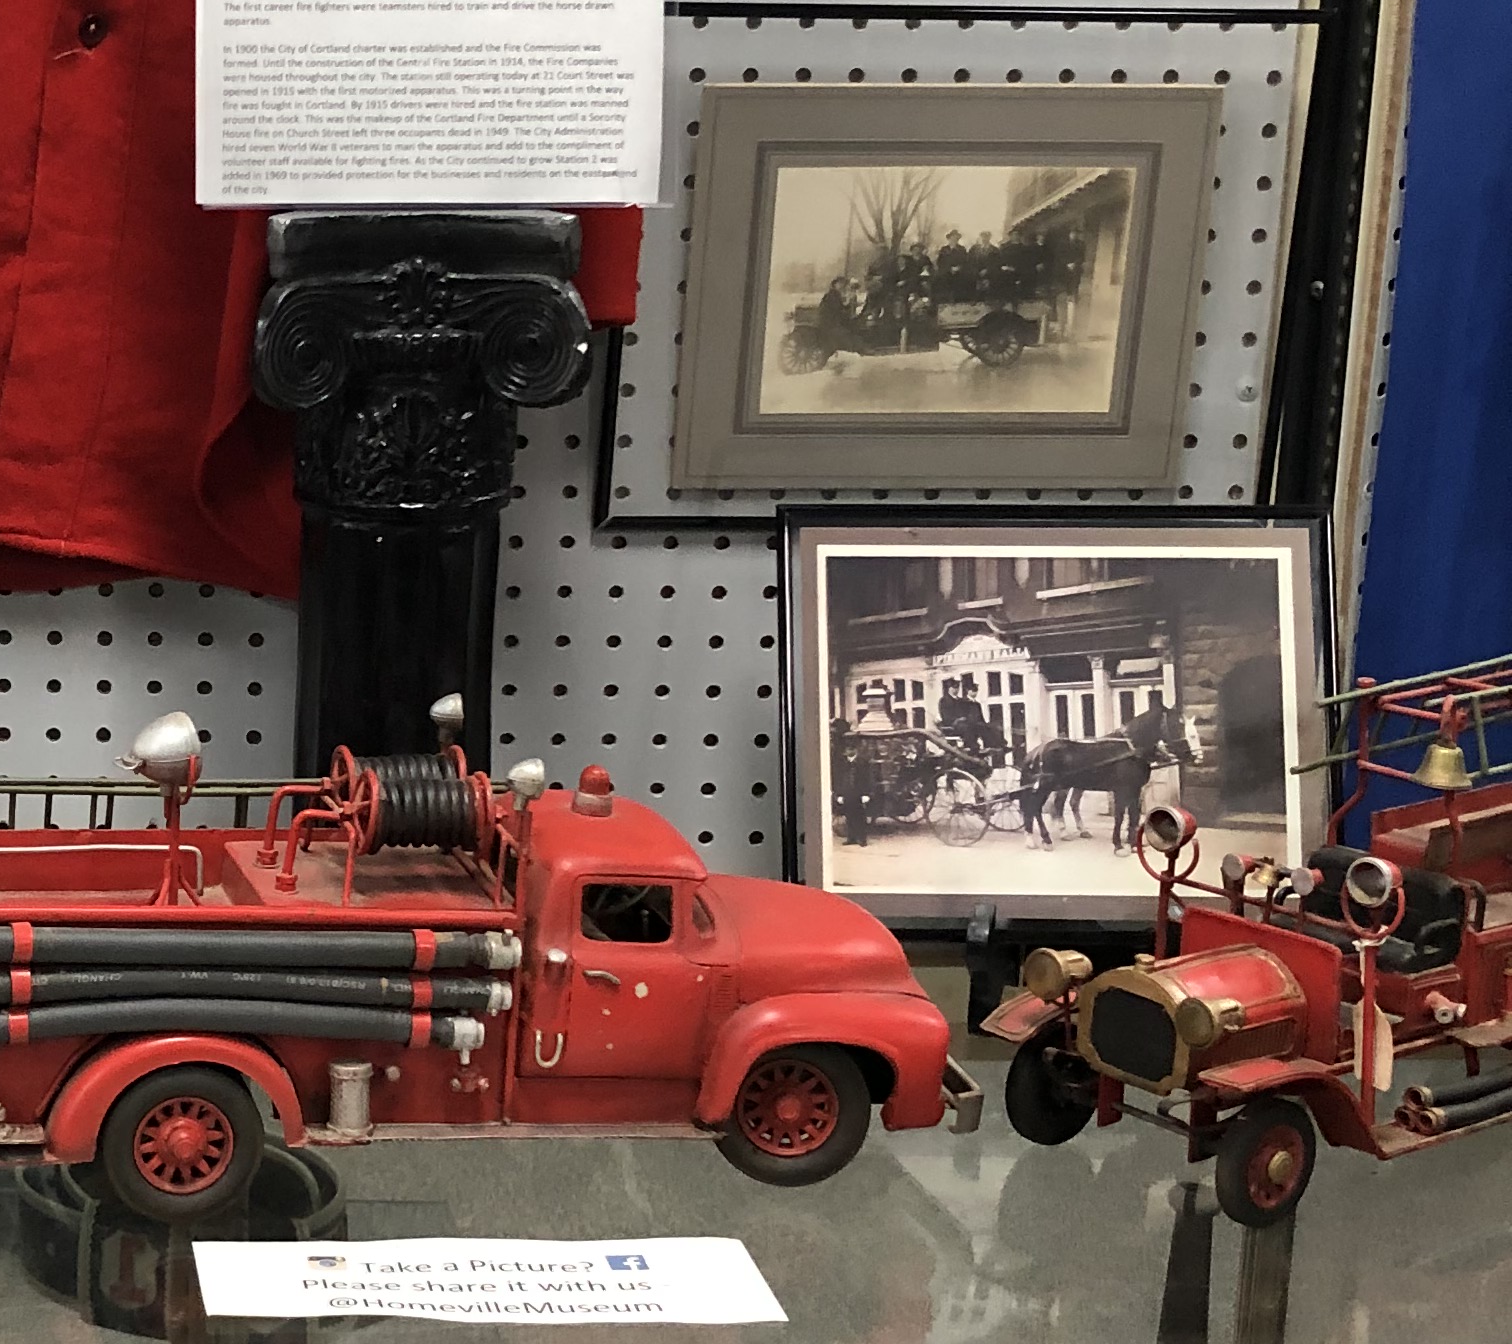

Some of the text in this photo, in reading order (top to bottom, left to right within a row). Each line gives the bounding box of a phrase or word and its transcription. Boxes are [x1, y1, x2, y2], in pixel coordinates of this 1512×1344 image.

[361, 1259, 594, 1273] Take a Picture?
[302, 1279, 652, 1293] Please share it with us
[328, 1297, 663, 1314] @HomevilleMuseum
